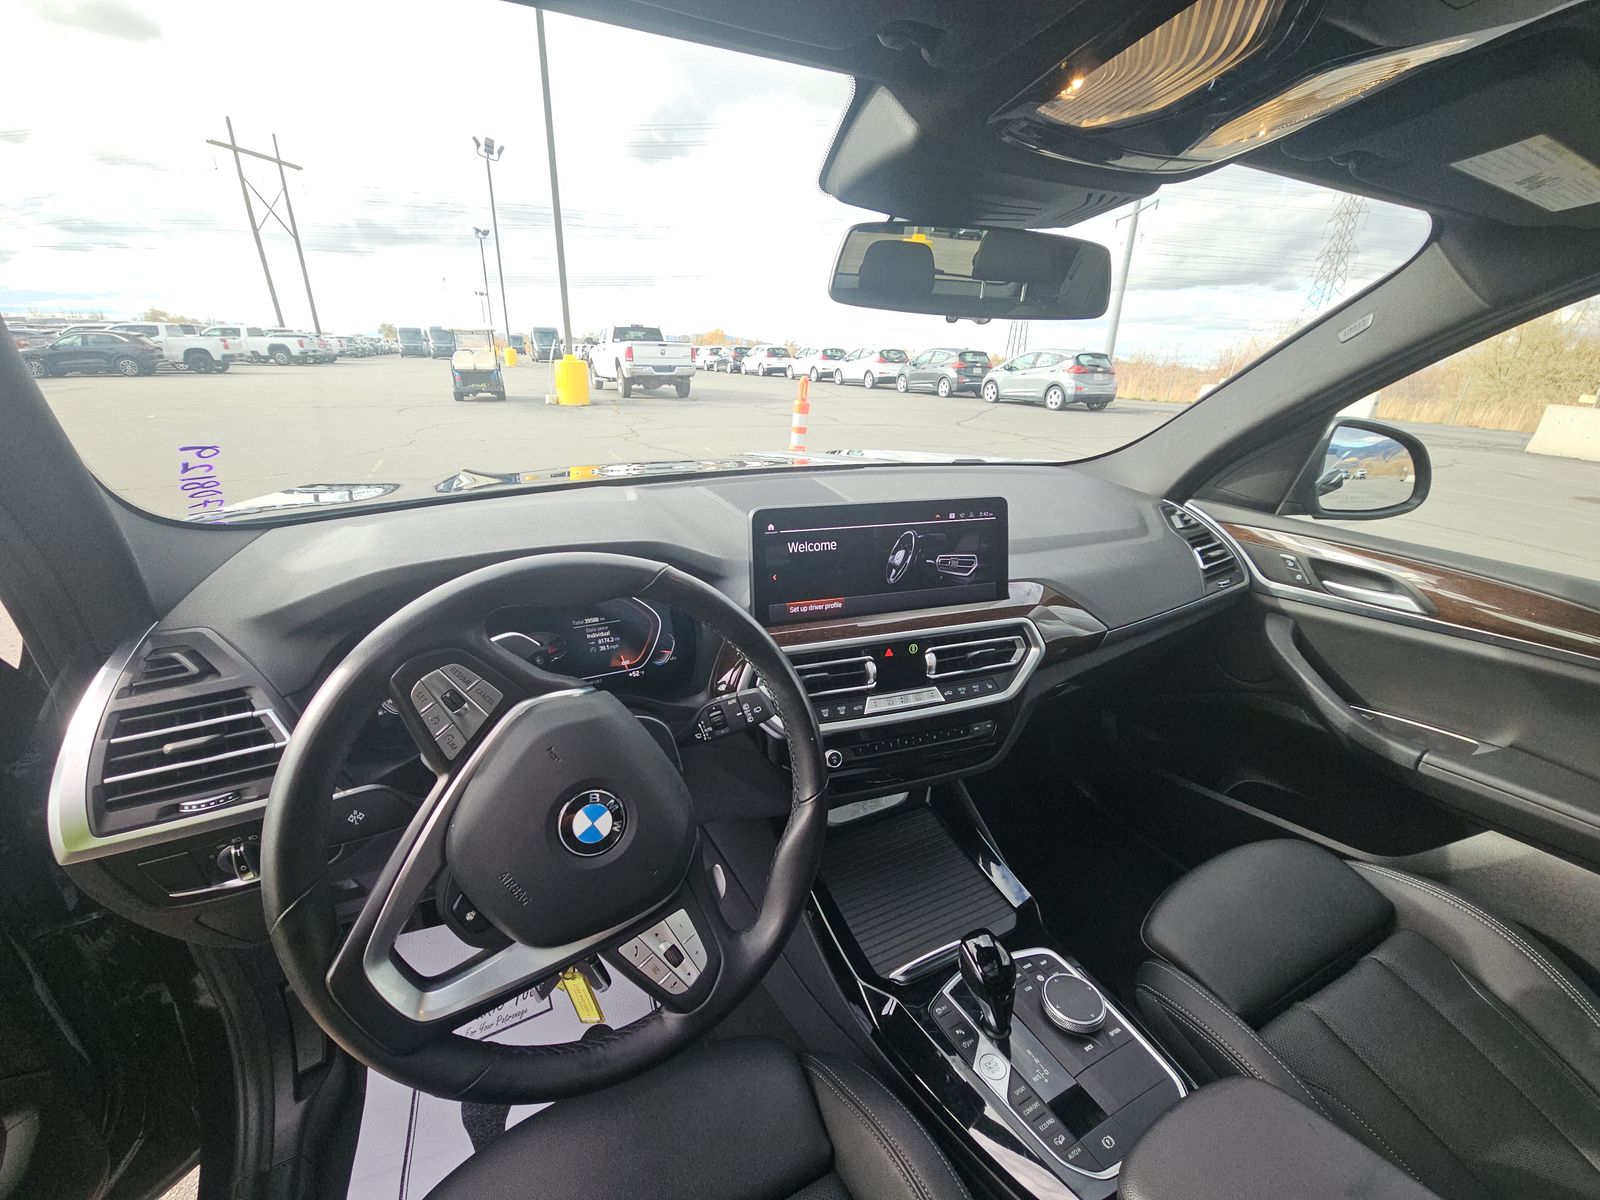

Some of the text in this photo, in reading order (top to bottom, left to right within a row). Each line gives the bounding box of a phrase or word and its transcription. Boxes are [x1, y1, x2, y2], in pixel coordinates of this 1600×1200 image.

[787, 541, 837, 553] Welcome
[824, 602, 843, 610] profile
[586, 630, 610, 639] Individual
[589, 792, 623, 832] BMW
[1022, 1101, 1041, 1116] COMFORT
